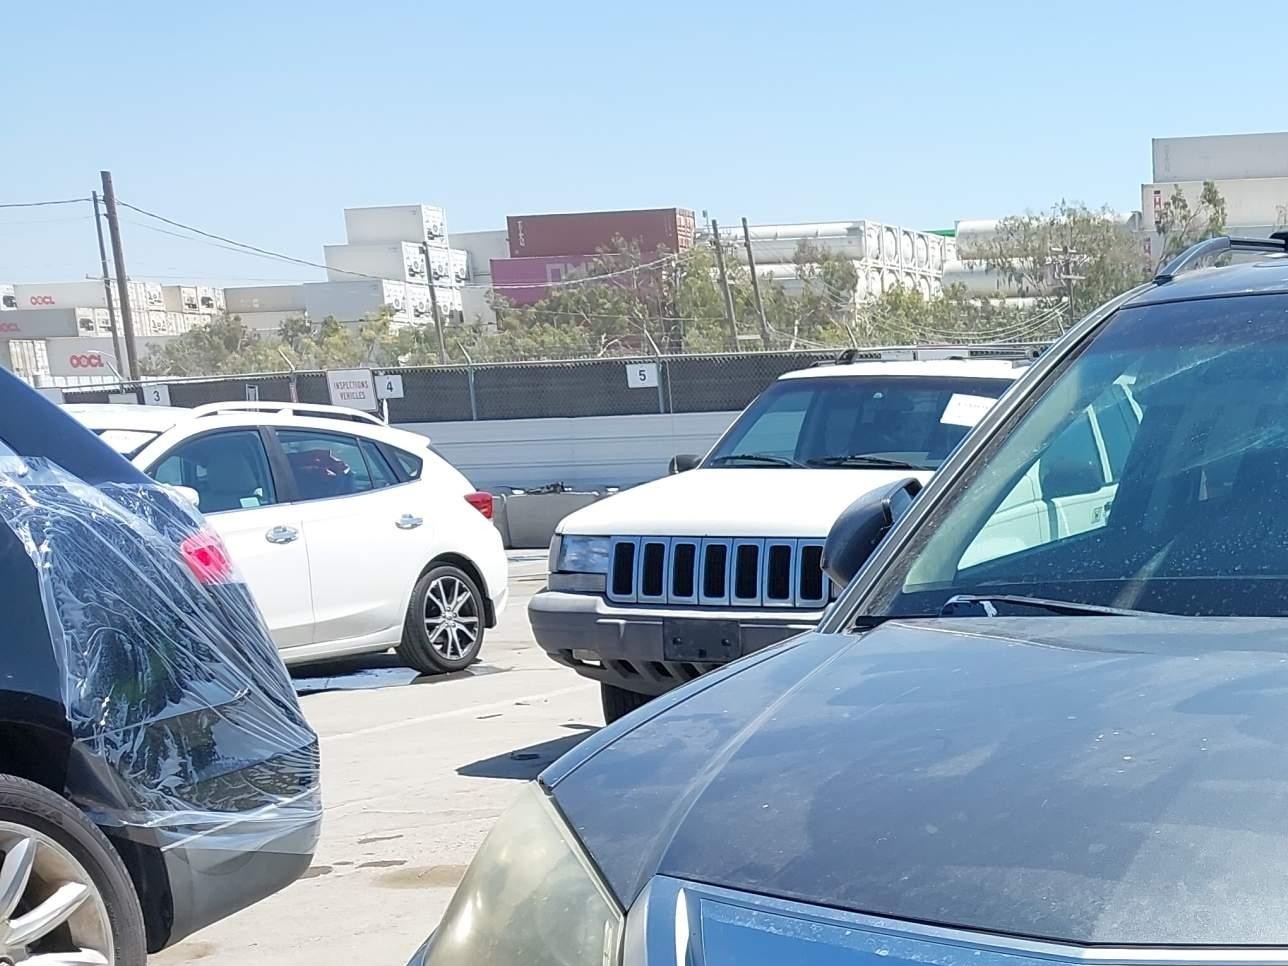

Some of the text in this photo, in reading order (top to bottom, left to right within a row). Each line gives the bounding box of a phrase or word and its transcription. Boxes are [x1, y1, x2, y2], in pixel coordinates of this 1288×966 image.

[31, 296, 55, 305] OOCL
[70, 355, 104, 367] OOCL
[639, 369, 647, 381] 5
[334, 381, 368, 390] INSPECTIONS
[387, 381, 393, 392] 4
[152, 390, 160, 402] 3
[340, 392, 365, 400] VEHICLES
